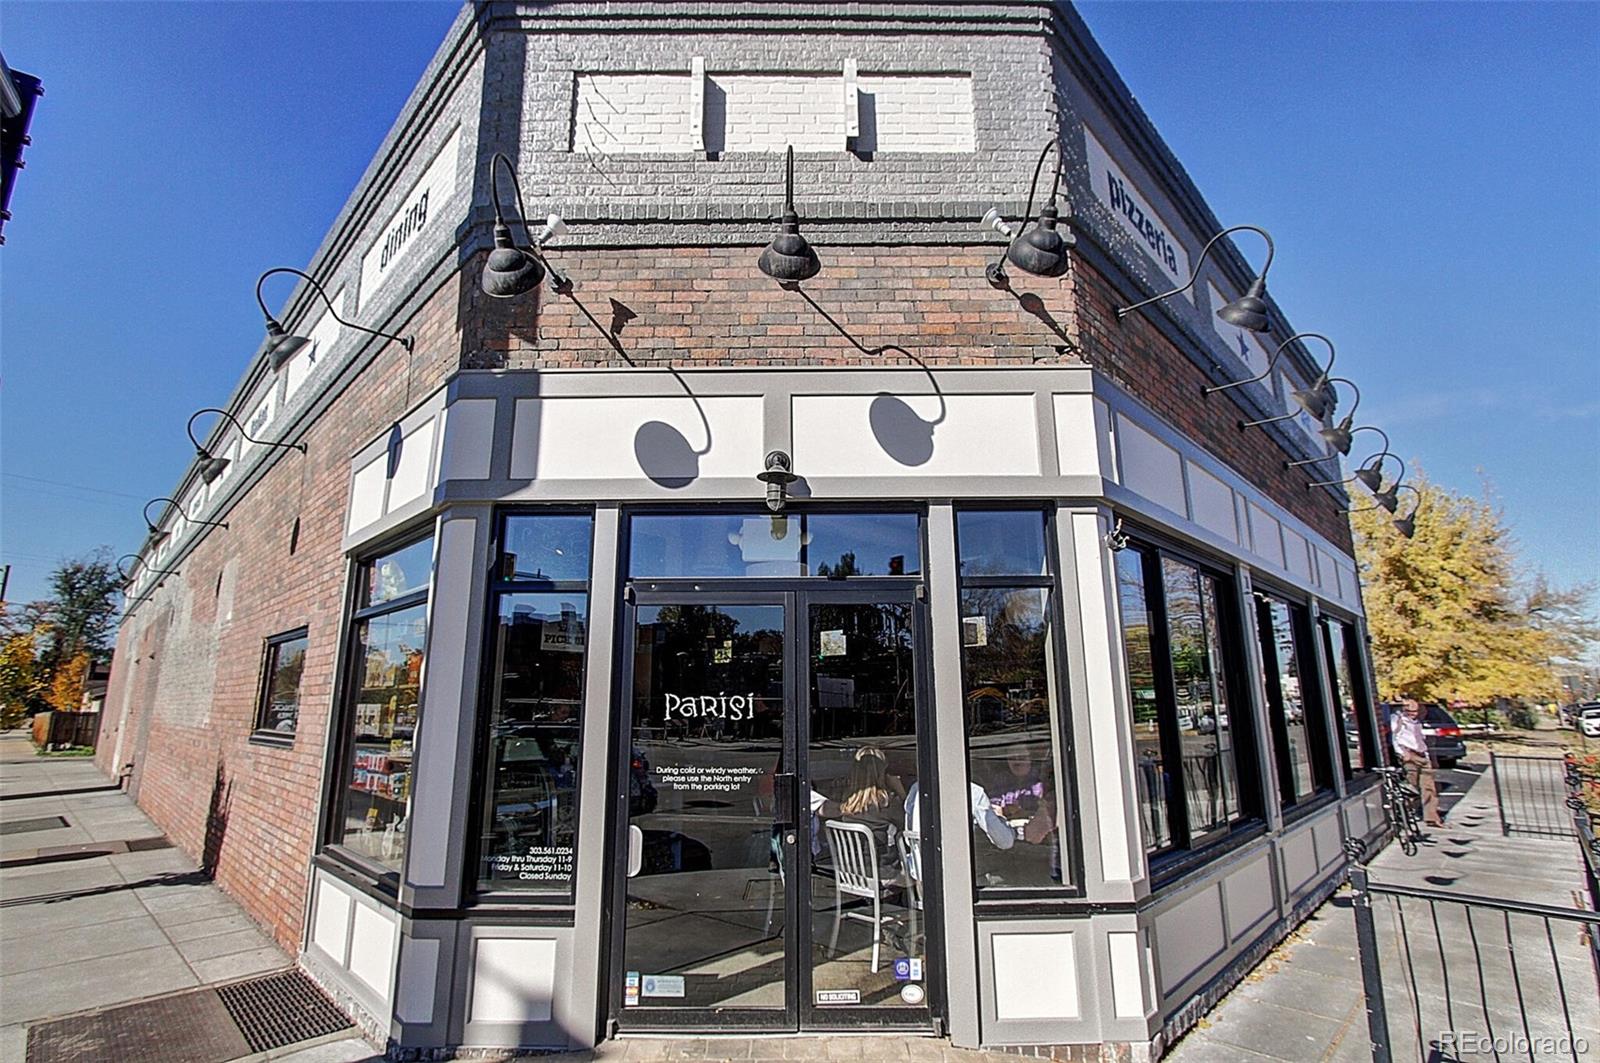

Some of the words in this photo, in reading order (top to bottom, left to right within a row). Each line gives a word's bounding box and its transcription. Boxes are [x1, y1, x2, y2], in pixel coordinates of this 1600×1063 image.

[1107, 170, 1179, 276] pizzeria
[379, 187, 430, 272] dining
[656, 766, 679, 775] During
[680, 766, 696, 774] cold
[705, 766, 726, 775] windy
[662, 775, 686, 783] please
[713, 775, 733, 783] North
[734, 775, 751, 783] entry
[703, 783, 730, 791] parking
[526, 855, 556, 864] Thursday
[520, 864, 552, 872] Saturday
[519, 872, 544, 880] Closed
[545, 872, 571, 881] Sunday
